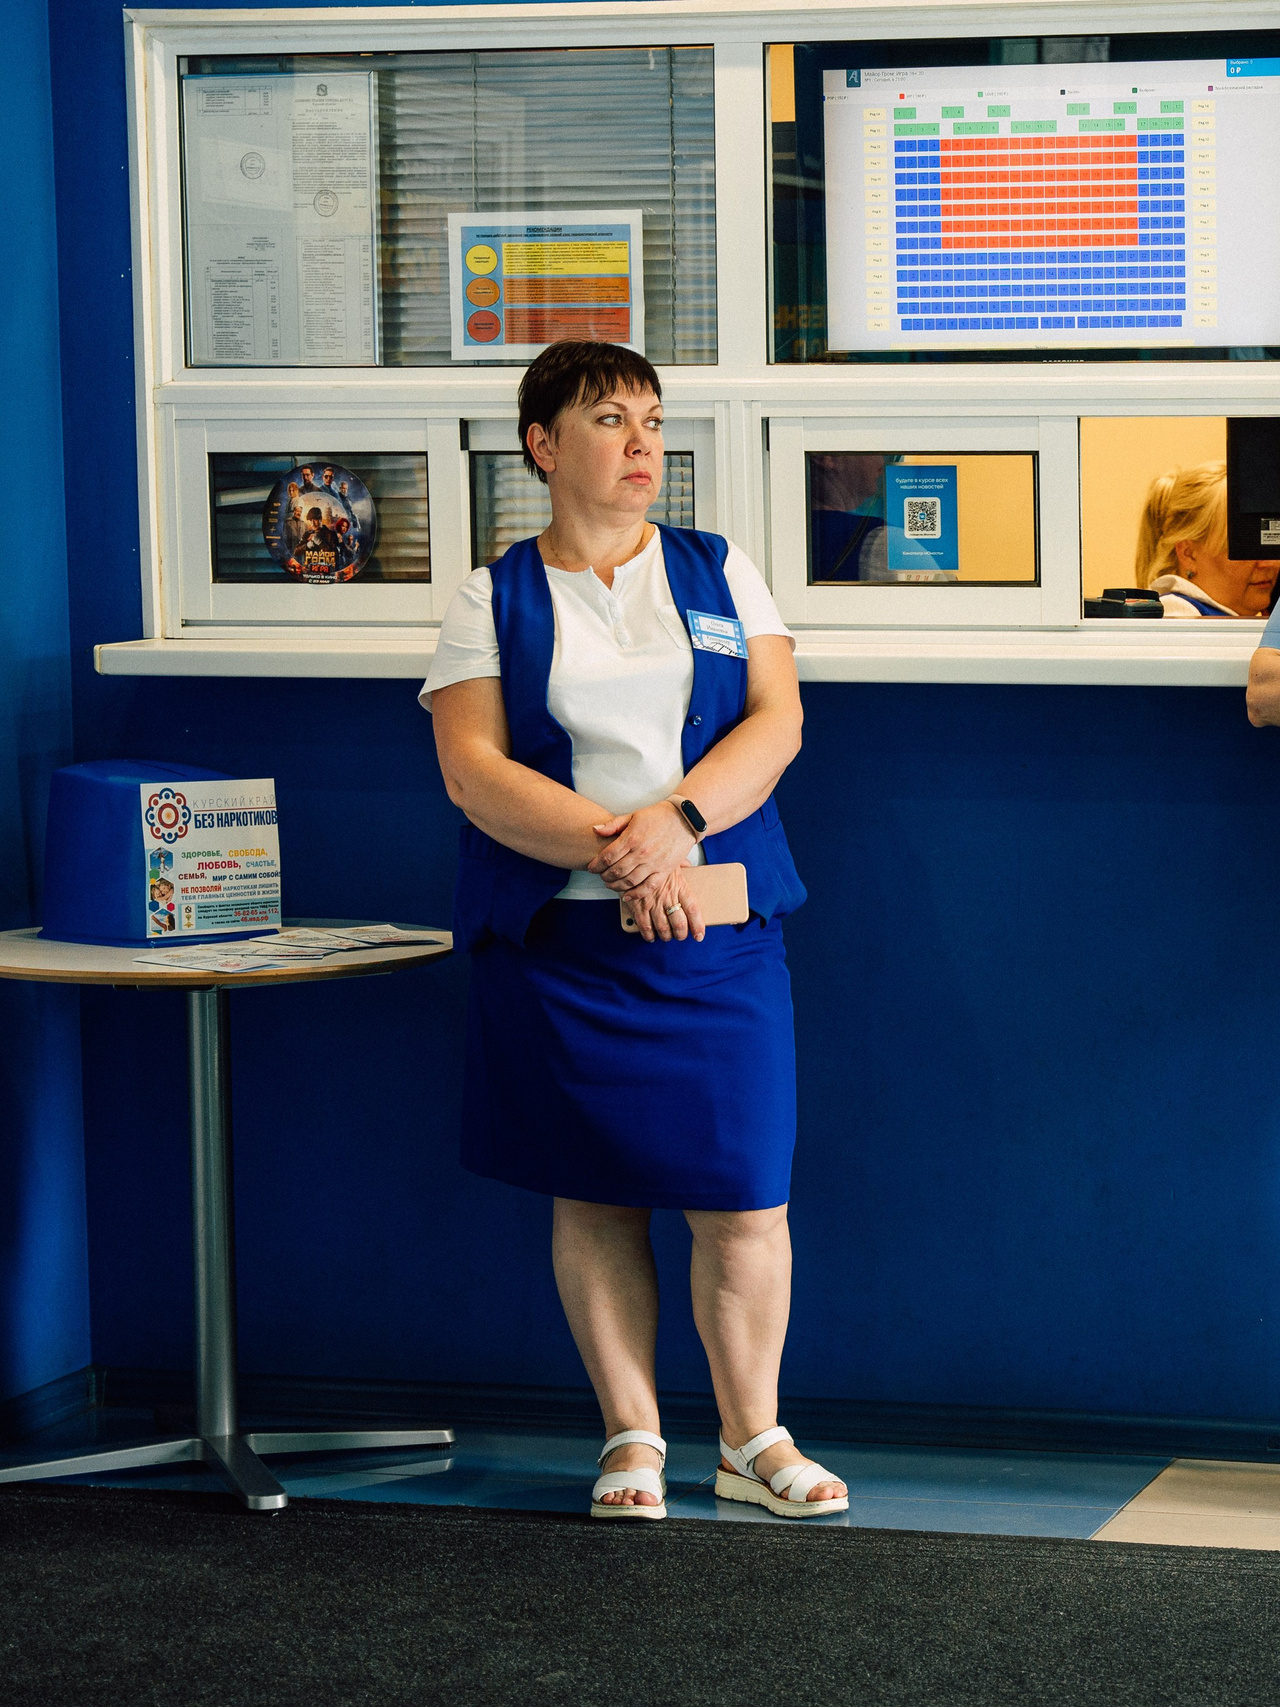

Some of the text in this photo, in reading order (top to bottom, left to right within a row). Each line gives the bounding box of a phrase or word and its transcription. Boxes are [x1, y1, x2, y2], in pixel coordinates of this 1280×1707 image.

[1230, 66, 1235, 74] 0
[305, 549, 335, 557] МАЙОР
[304, 556, 336, 567] ГРОМ
[192, 794, 276, 809] КУРСКИЙ КРАЙ
[194, 810, 279, 829] БЕЗ НАРКОТИКОВ
[181, 848, 268, 859] ЗДОРОВЬЕ, СВОБОДА,
[197, 860, 276, 870] ЛЮБОВЬ, СЧАСТЬЕ,
[178, 872, 207, 880] СЕМЬЯ,
[181, 886, 189, 894] НЕ
[190, 884, 222, 894] ПОЗВОЛЯЙ
[226, 890, 256, 898] ЦЕННОСТЕЙ
